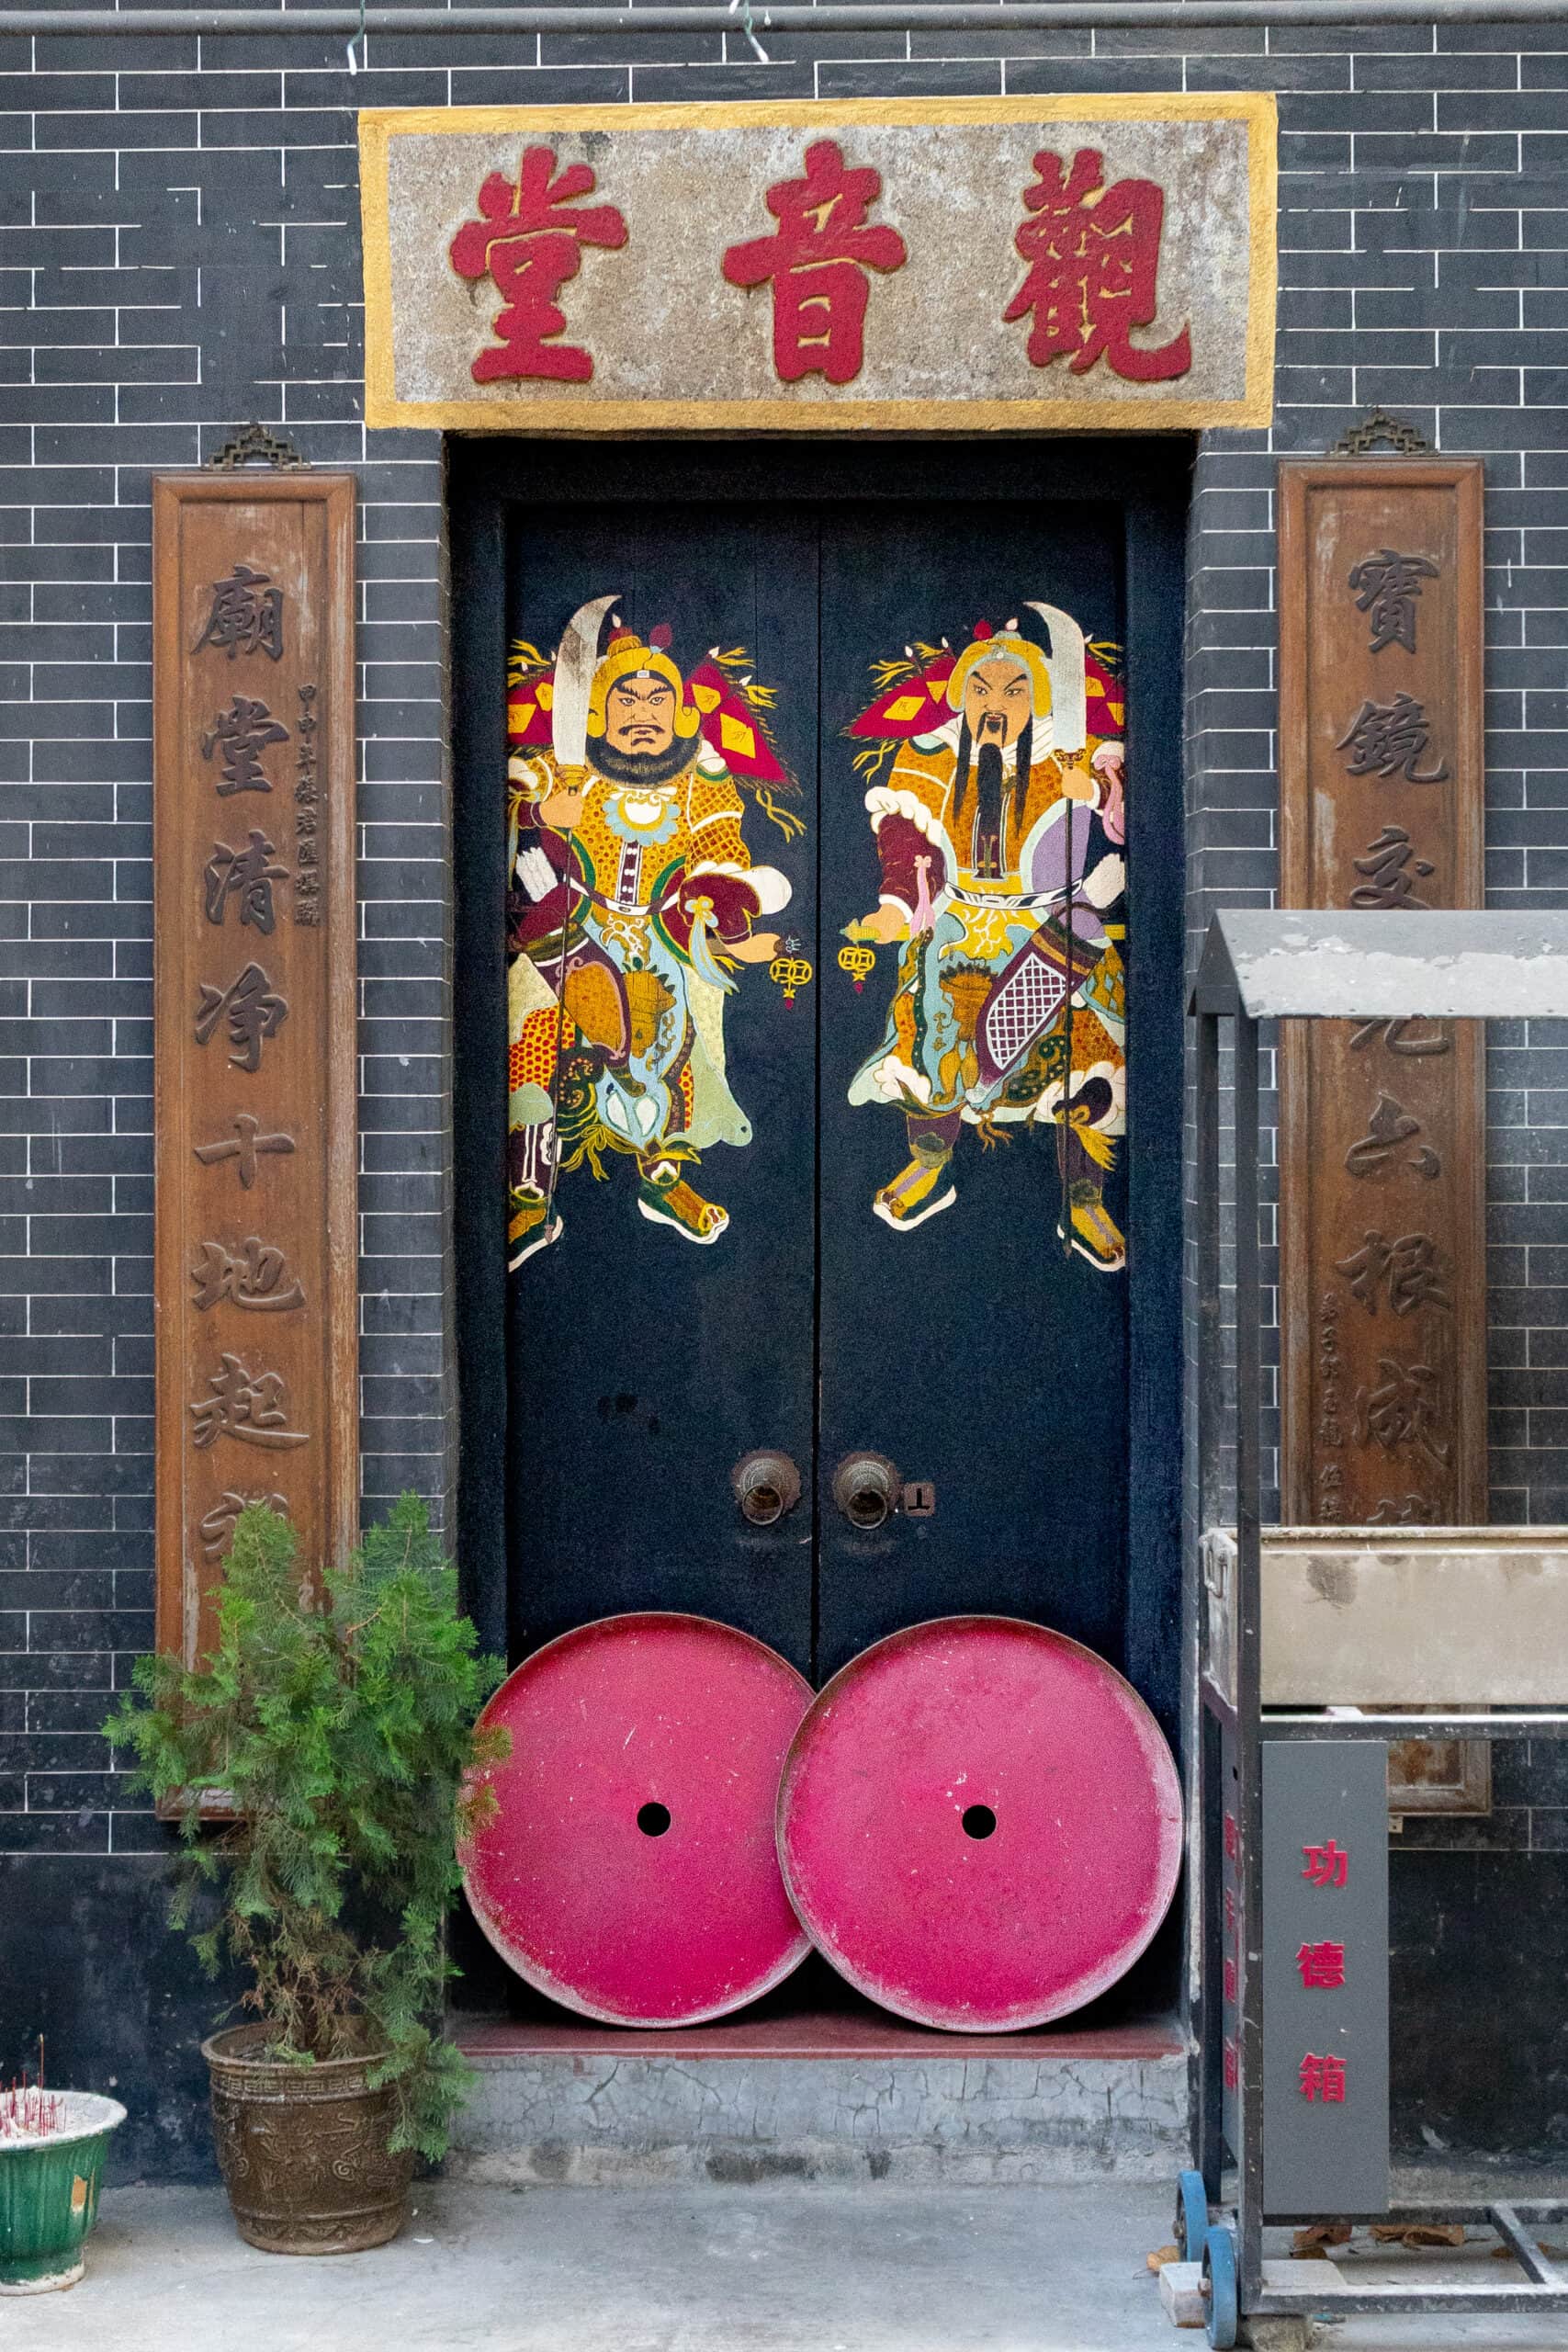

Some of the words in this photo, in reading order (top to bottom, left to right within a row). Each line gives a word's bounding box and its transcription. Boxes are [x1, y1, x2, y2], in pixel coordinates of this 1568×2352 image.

[449, 138, 1192, 384] 觀音堂
[1295, 1839, 1348, 2103] 功德箱
